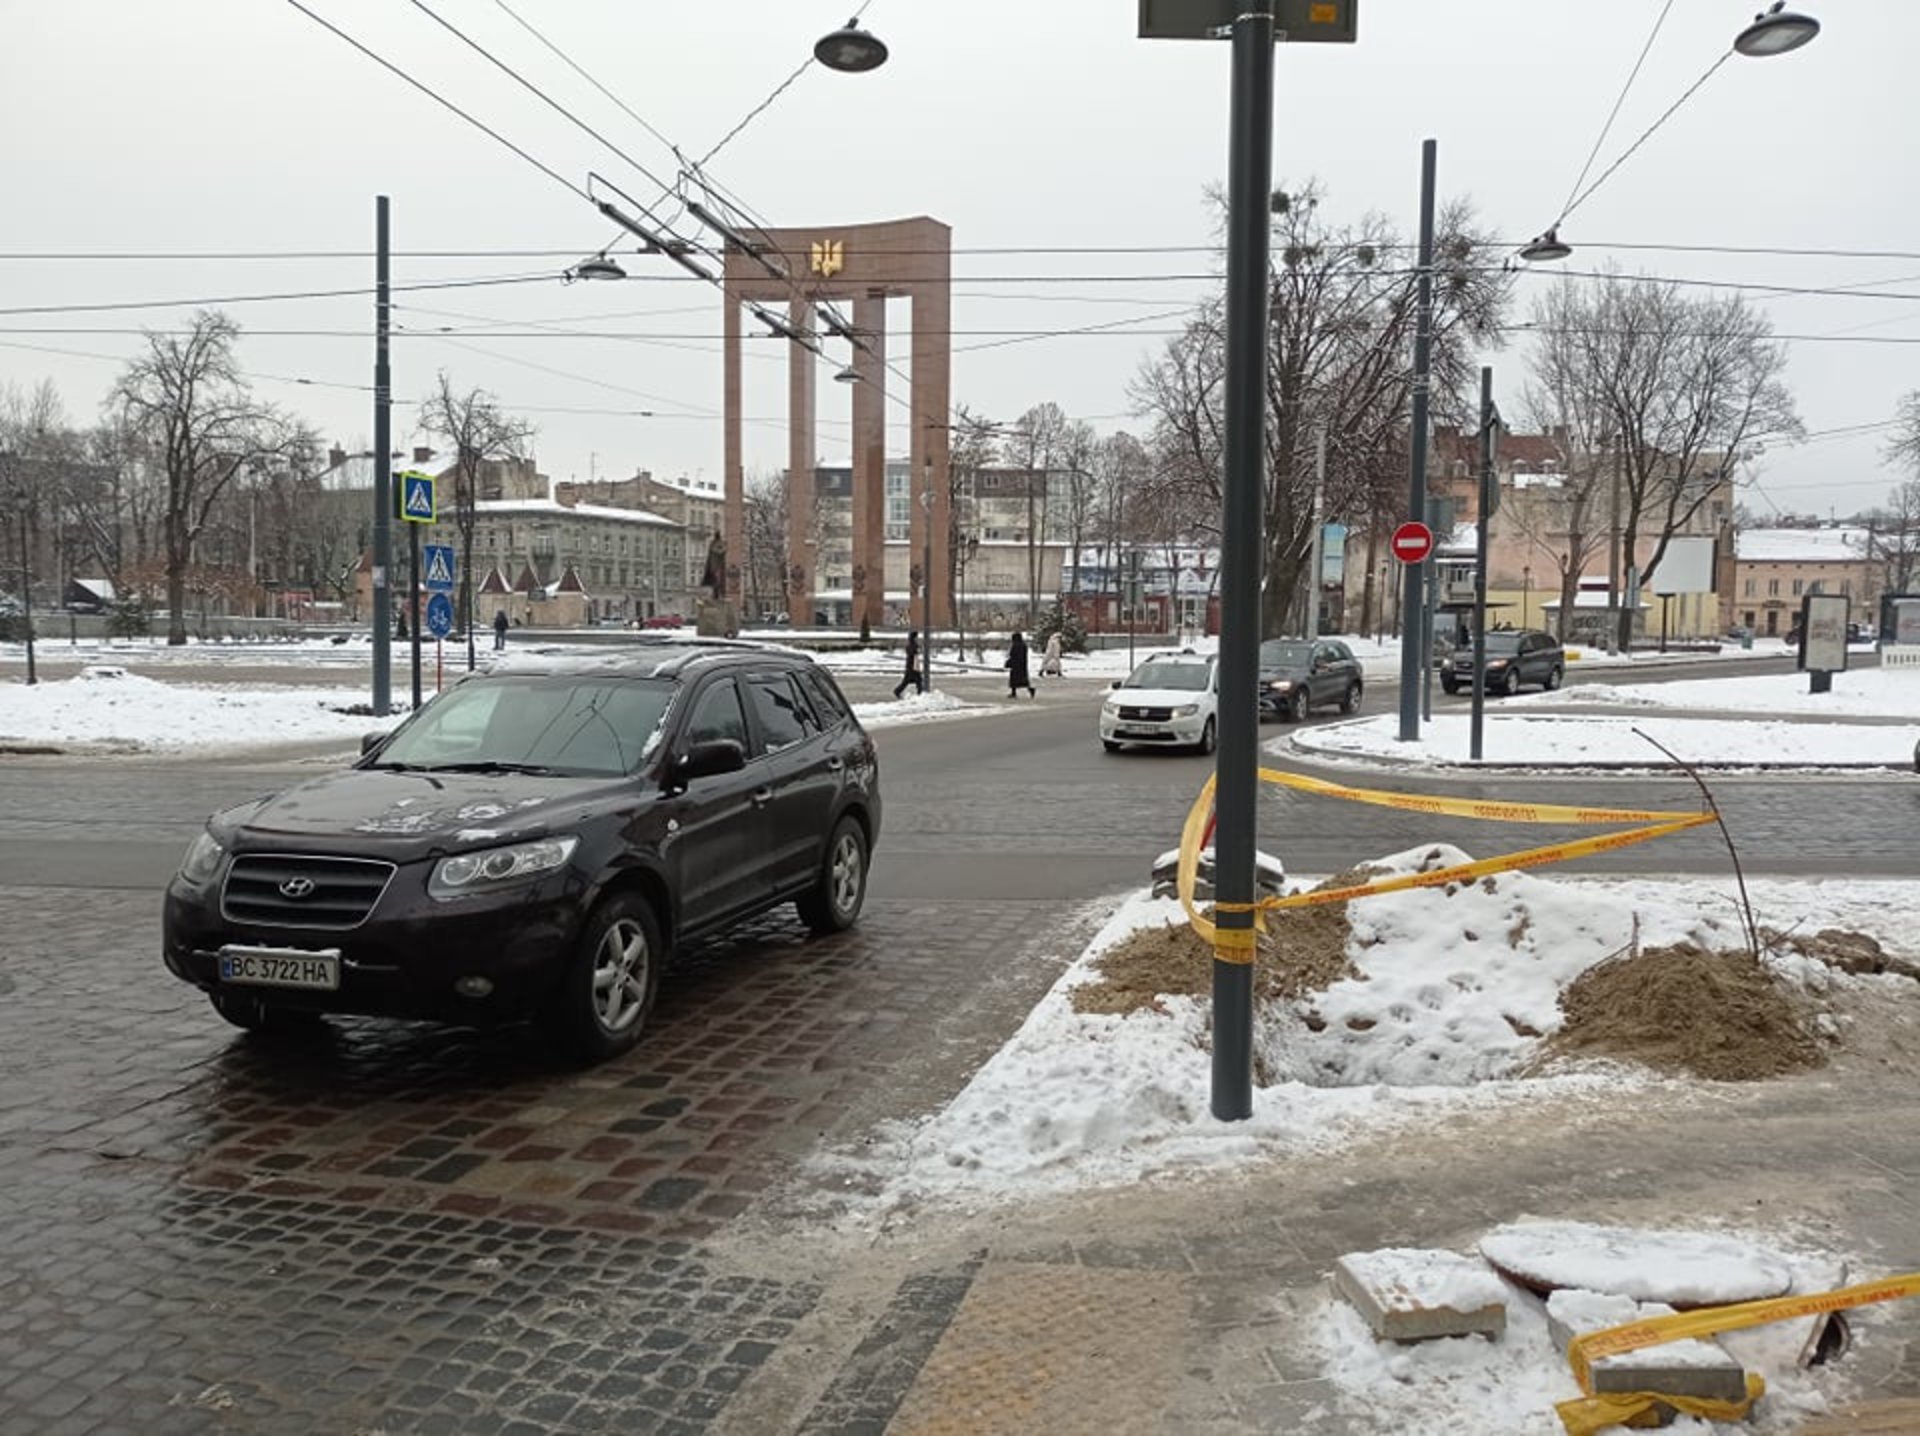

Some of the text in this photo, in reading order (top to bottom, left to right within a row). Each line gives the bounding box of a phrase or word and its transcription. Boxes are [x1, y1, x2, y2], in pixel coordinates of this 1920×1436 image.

[231, 957, 328, 982] BC 3722 HA
